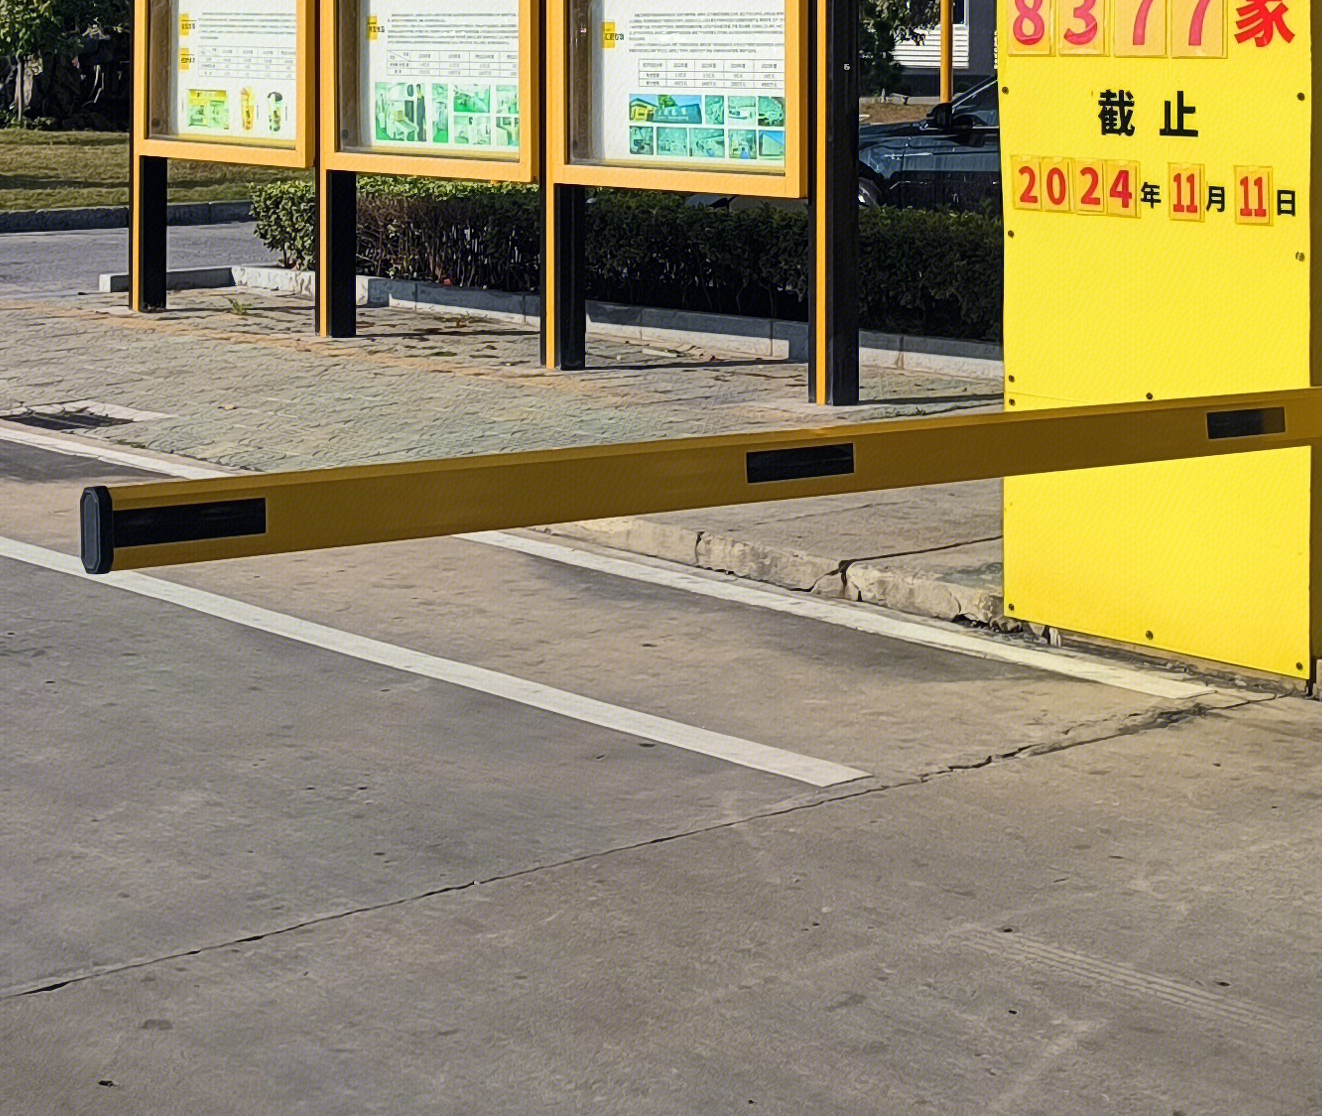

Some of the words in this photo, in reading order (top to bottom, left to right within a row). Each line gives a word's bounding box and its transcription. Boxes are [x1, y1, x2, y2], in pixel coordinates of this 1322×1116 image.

[1097, 89, 1199, 138] 截止
[1018, 165, 1296, 218] 2024年11月11日
